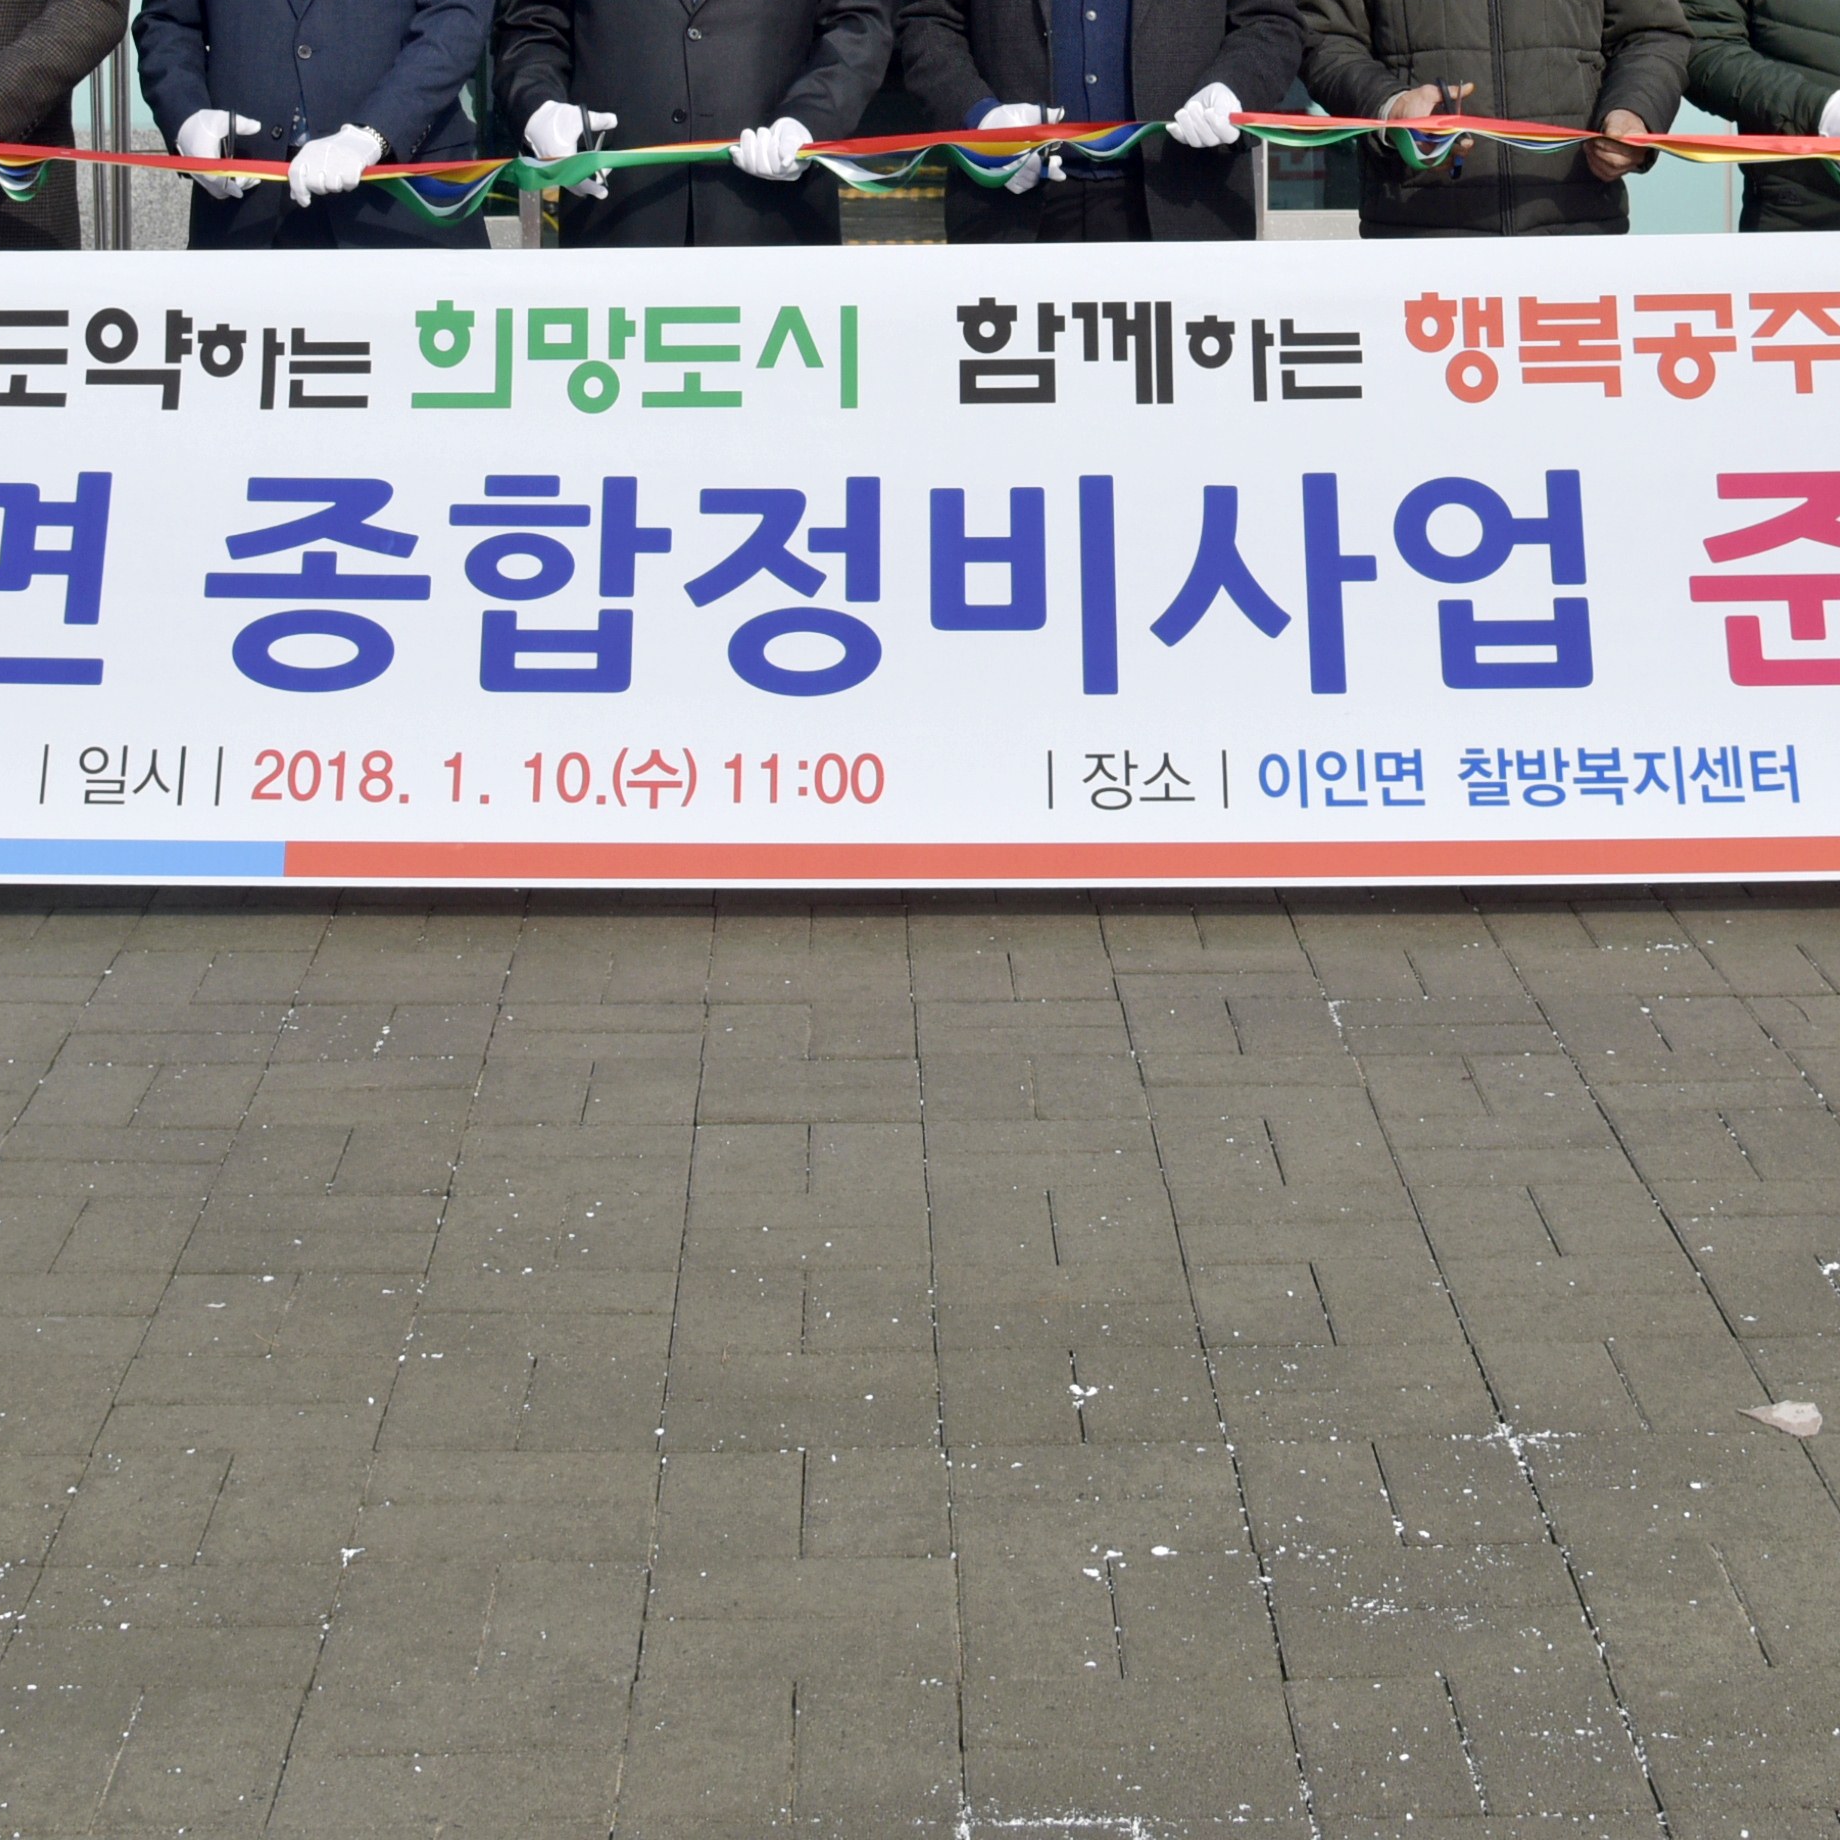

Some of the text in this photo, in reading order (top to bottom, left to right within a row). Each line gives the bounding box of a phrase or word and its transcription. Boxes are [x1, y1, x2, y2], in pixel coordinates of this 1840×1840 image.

[410, 299, 859, 415] 희망도시
[956, 296, 1364, 406] 함께하는
[203, 468, 1594, 698] 종합정비사업
[78, 745, 885, 810] 일시 2018. 1. 10.(수) 11:00
[1081, 744, 1801, 811] 장소 이인면 찰방복지센터
